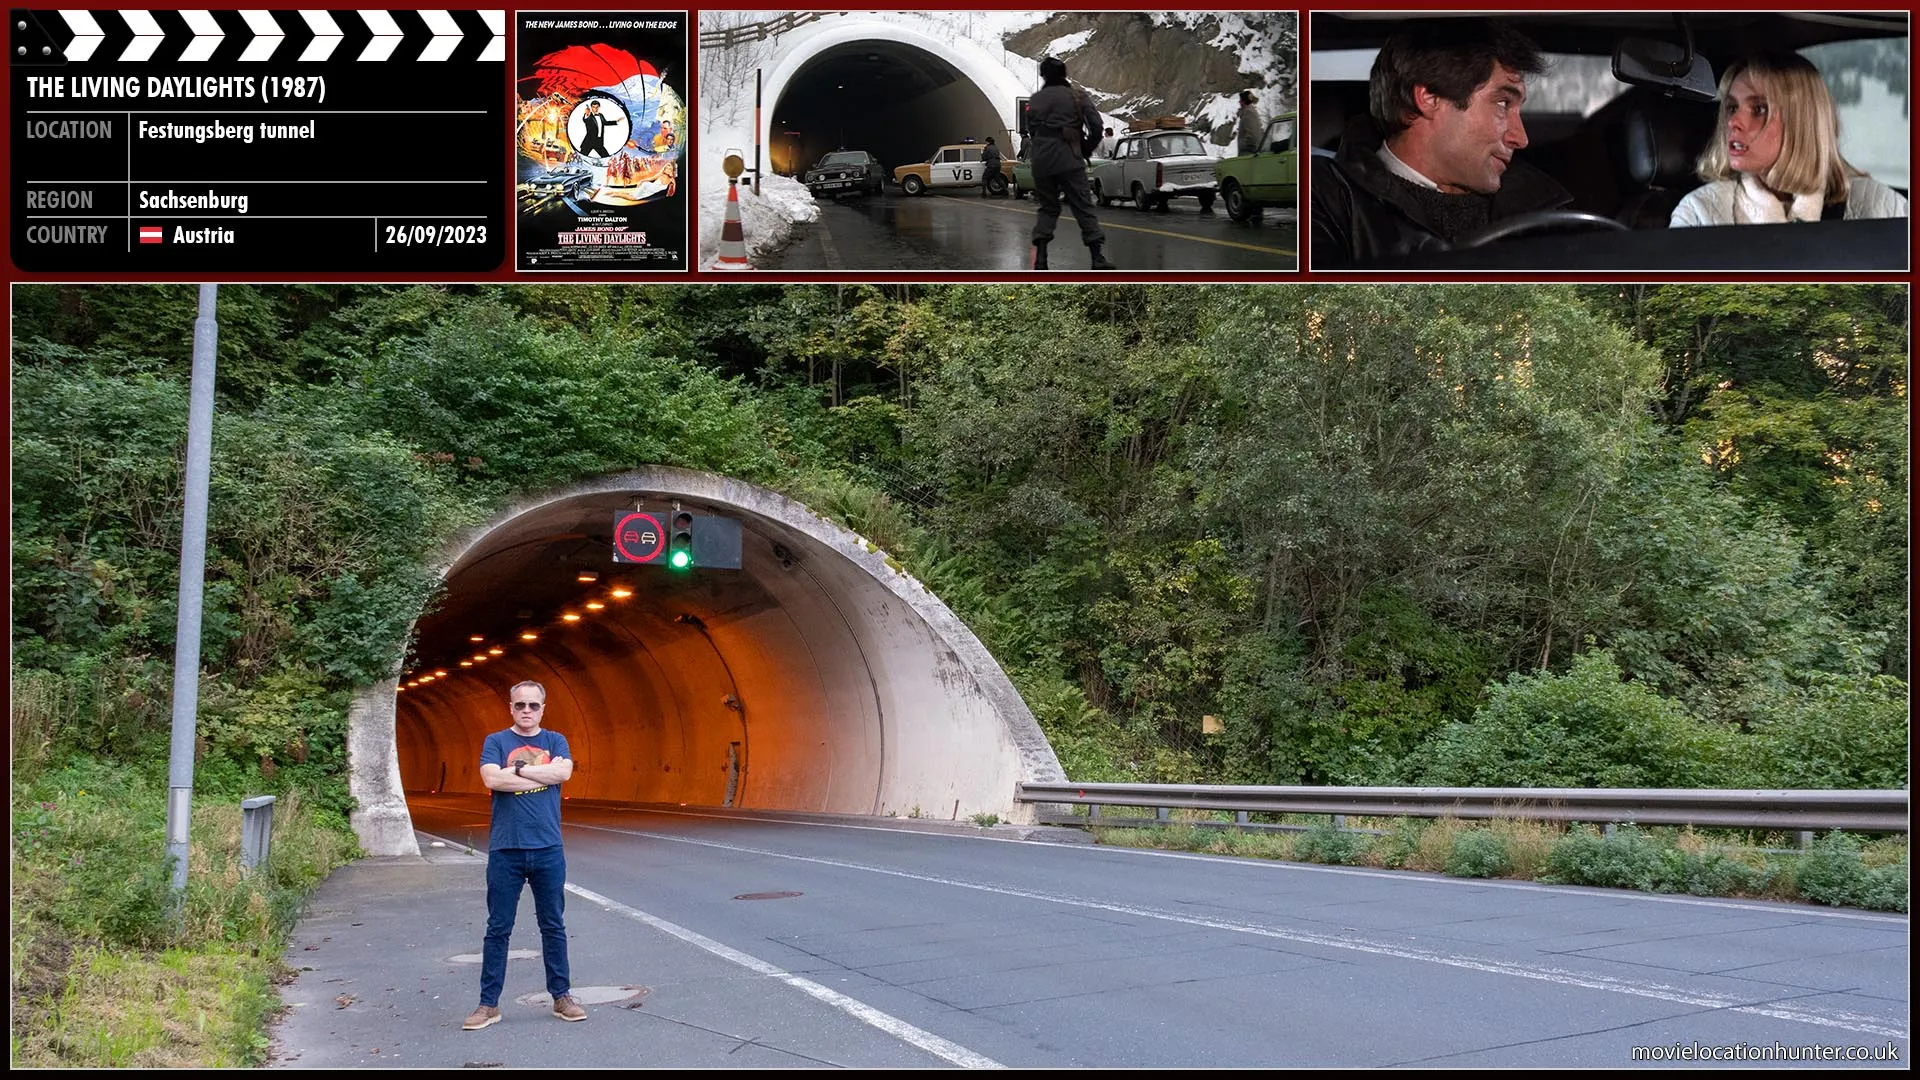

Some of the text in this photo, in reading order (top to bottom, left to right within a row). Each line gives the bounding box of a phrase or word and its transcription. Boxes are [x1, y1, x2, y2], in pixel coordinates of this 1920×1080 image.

[525, 20, 538, 29] THE
[538, 20, 555, 29] NEW
[555, 20, 578, 29] JAMES
[609, 20, 632, 29] LIVING
[633, 20, 645, 29] ON
[645, 20, 658, 29] THE
[658, 20, 678, 29] EDGE
[952, 169, 973, 181] VB
[558, 232, 647, 245] THE LIVING DAYLIGHTS
